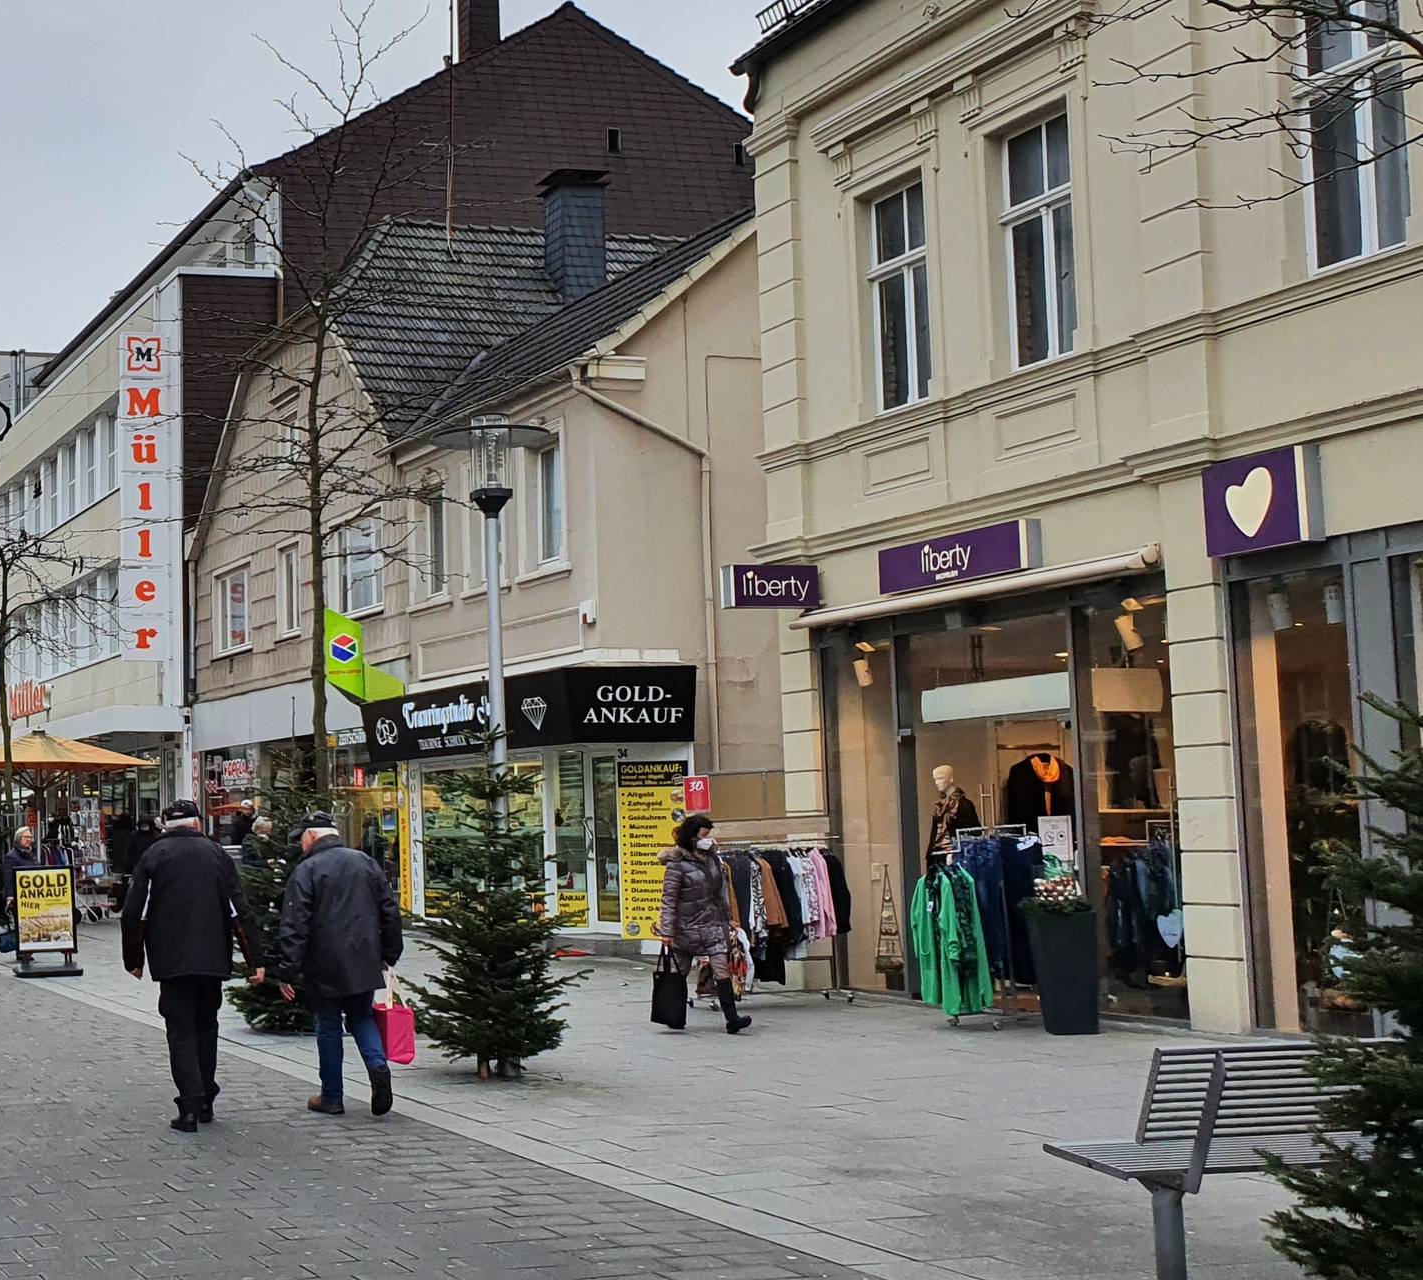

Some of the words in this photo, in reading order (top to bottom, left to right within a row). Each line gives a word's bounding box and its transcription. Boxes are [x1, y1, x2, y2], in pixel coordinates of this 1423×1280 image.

[126, 387, 161, 650] Müller
[921, 543, 972, 574] liberty
[742, 570, 810, 602] liberty
[9, 680, 48, 720] Müller
[596, 685, 673, 702] GOLD-
[582, 706, 685, 724] ANKAUF
[617, 748, 628, 759] 34
[620, 764, 683, 774] GOLDANKAUF:
[627, 791, 654, 799] Altgold
[627, 800, 663, 808] Zahngold
[18, 873, 68, 889] GOLD
[19, 887, 69, 899] ANKAUF
[20, 901, 41, 910] HIER
